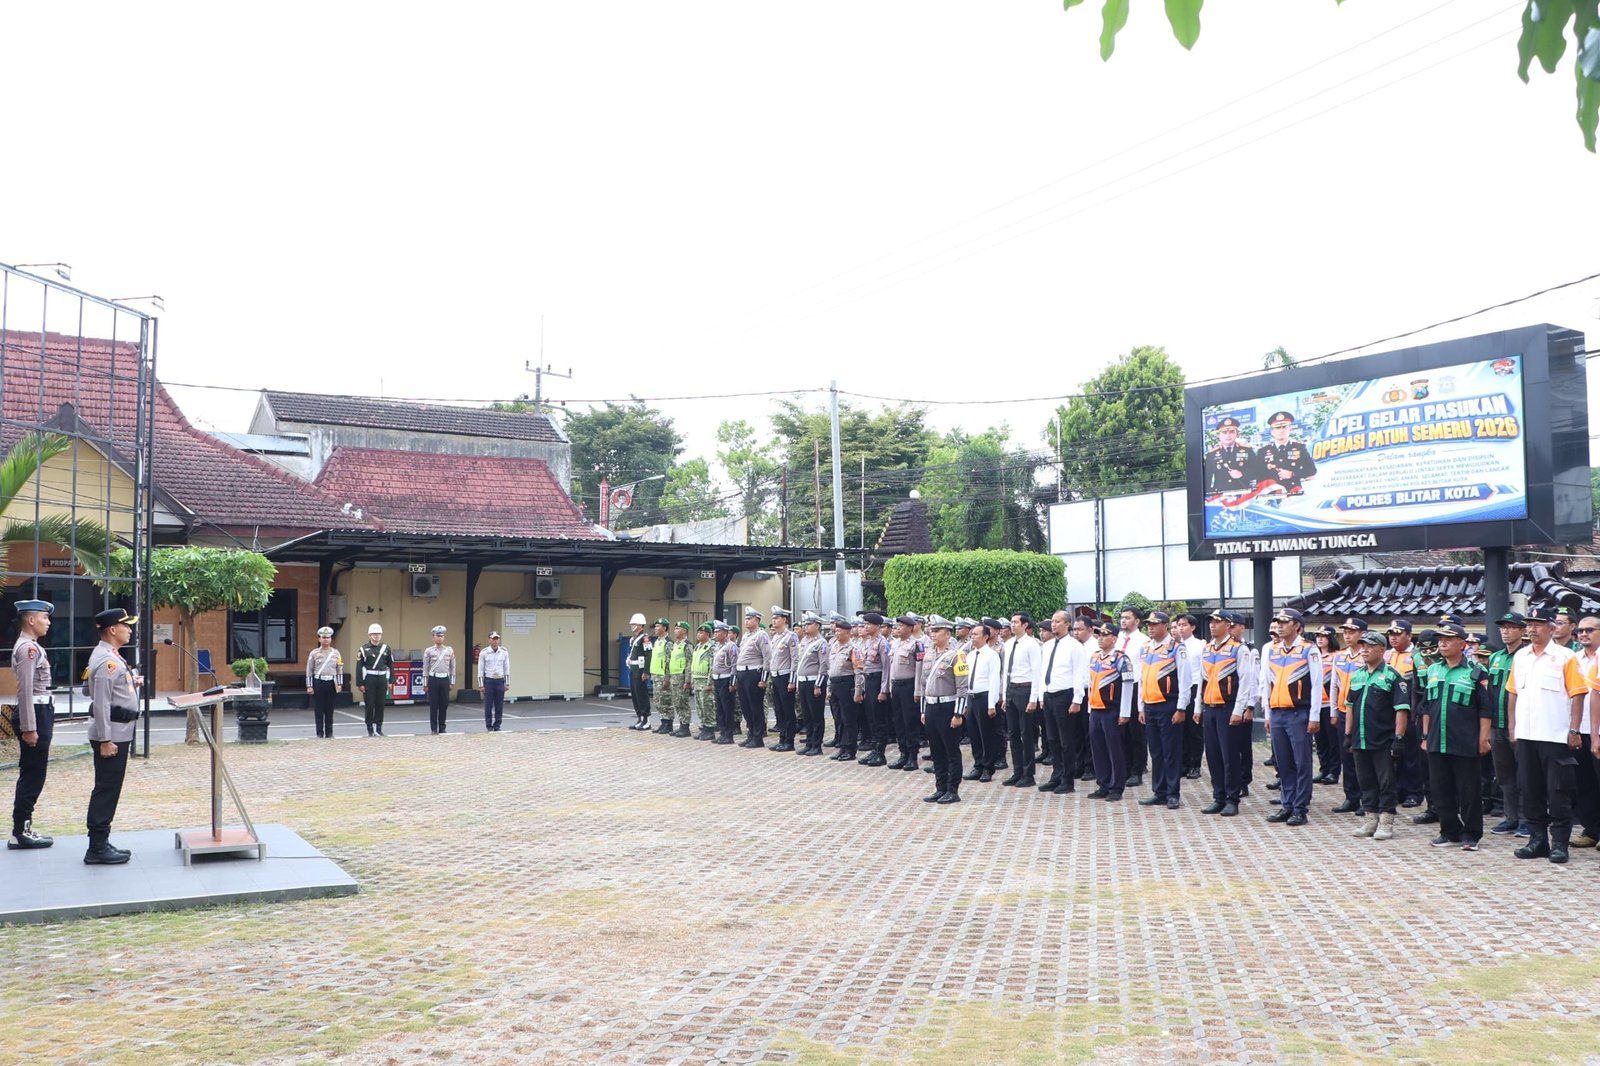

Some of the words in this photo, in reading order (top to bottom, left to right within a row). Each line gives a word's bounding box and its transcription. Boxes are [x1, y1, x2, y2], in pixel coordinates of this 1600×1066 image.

[1327, 415, 1365, 437] APEL
[1369, 405, 1421, 429] GELAR
[1424, 394, 1508, 421] PASUKAN
[1312, 436, 1366, 460] OPERASI
[1369, 427, 1409, 448] PATUH
[1412, 419, 1473, 442] SEMERU
[1474, 416, 1519, 438] 2026
[1346, 493, 1393, 509] POLRES
[1396, 489, 1441, 505] BLITAR
[1444, 485, 1481, 501] KOTA
[1213, 541, 1252, 555] TATAG
[1252, 537, 1318, 553] TRAWANG
[1319, 533, 1378, 549] TUNGGA
